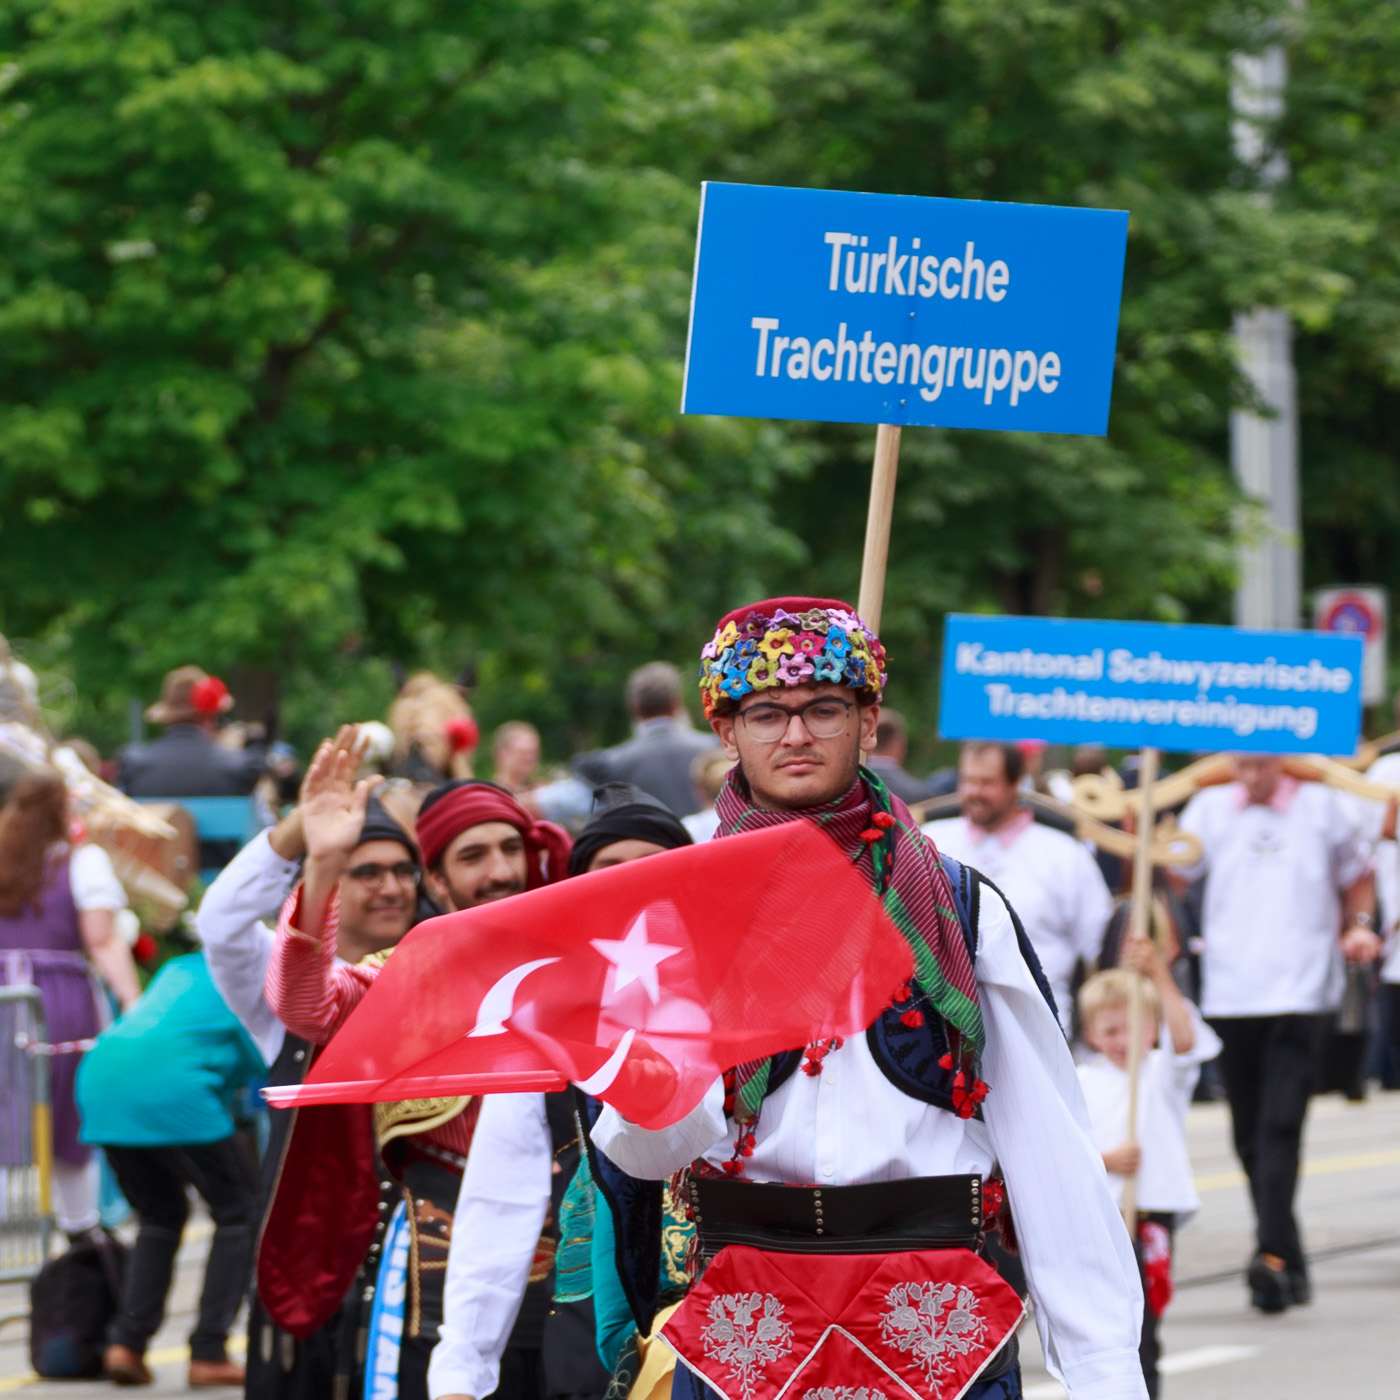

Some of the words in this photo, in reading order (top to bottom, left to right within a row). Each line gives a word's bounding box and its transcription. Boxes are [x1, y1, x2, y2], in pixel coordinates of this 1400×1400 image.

[824, 231, 1010, 302] Türkische
[751, 316, 1061, 407] Trachtengruppe
[956, 642, 1105, 682] Kantonal
[1107, 649, 1353, 694] Schwyzerische
[985, 682, 1319, 740] Trachtenvereinigung
